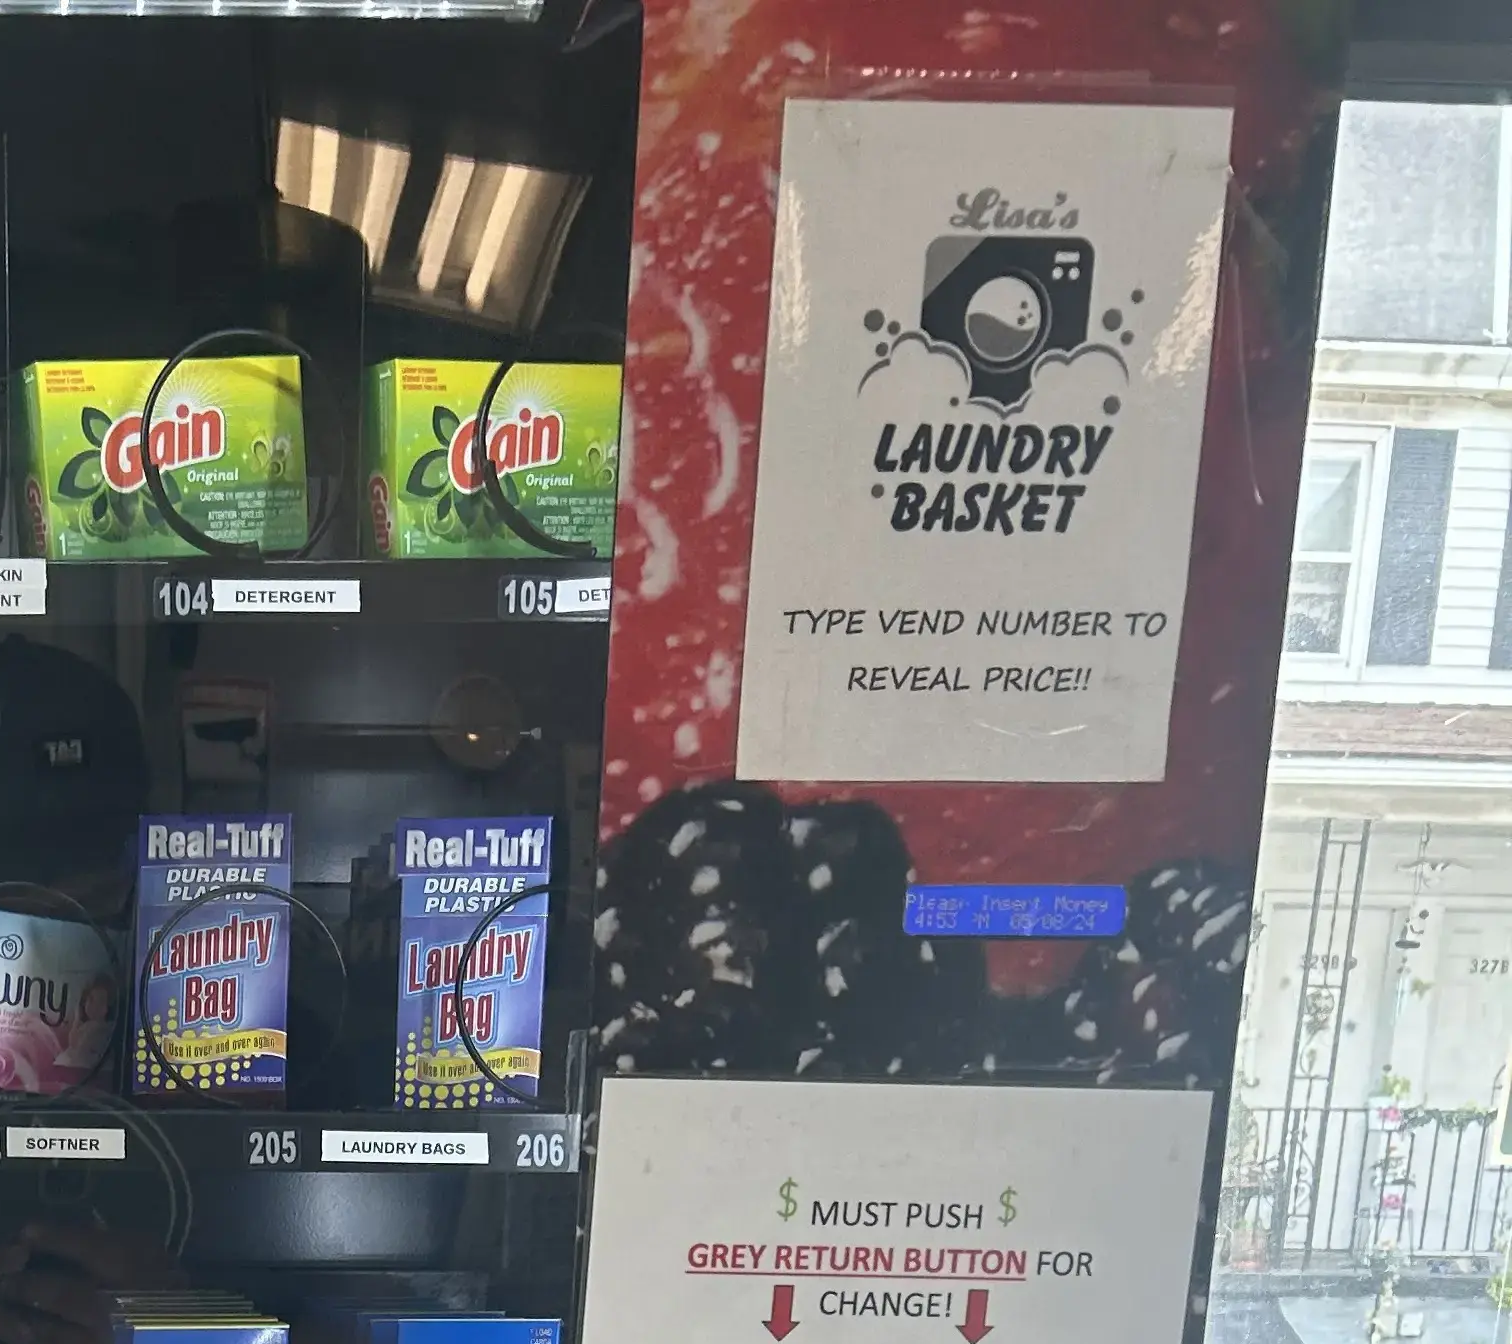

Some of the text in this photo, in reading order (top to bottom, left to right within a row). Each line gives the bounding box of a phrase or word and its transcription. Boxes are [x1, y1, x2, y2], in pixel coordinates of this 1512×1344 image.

[950, 187, 1080, 231] Lisa's
[104, 403, 223, 490] Gain
[449, 407, 561, 490] Gain
[875, 424, 1113, 477] LAUNDRY
[186, 467, 239, 486] Original
[525, 472, 574, 490] Original
[891, 482, 1087, 535] BASKET
[158, 581, 337, 617] 104 DETERGENT
[503, 580, 553, 616] 105
[783, 609, 1167, 638] TYPE VEND NUMBER TO
[847, 666, 1092, 693] REVEAL PRICE!!
[147, 823, 285, 861] Real-Tuff
[404, 828, 546, 868] Real-Tuff
[166, 867, 267, 884] DURABLE
[423, 876, 526, 894] DURABLE
[914, 912, 959, 929] 4:53
[981, 895, 1041, 912] Insert
[1054, 895, 1109, 914] Money
[152, 913, 274, 977] Laundry
[408, 927, 531, 993] Laundry
[184, 975, 238, 1024] Bag
[439, 991, 494, 1042] Bag
[194, 1045, 213, 1058] over
[232, 1037, 251, 1051] over
[25, 1137, 100, 1153] SOFTNER
[248, 1131, 298, 1165] 205
[341, 1140, 467, 1156] LAUNDRY BAGS
[515, 1133, 565, 1168] 206
[810, 1200, 898, 1228] MUST
[905, 1201, 984, 1229] PUSH
[687, 1243, 1094, 1278] GREY RETURN BUTTON FOR
[818, 1290, 952, 1318] CHANGE!
